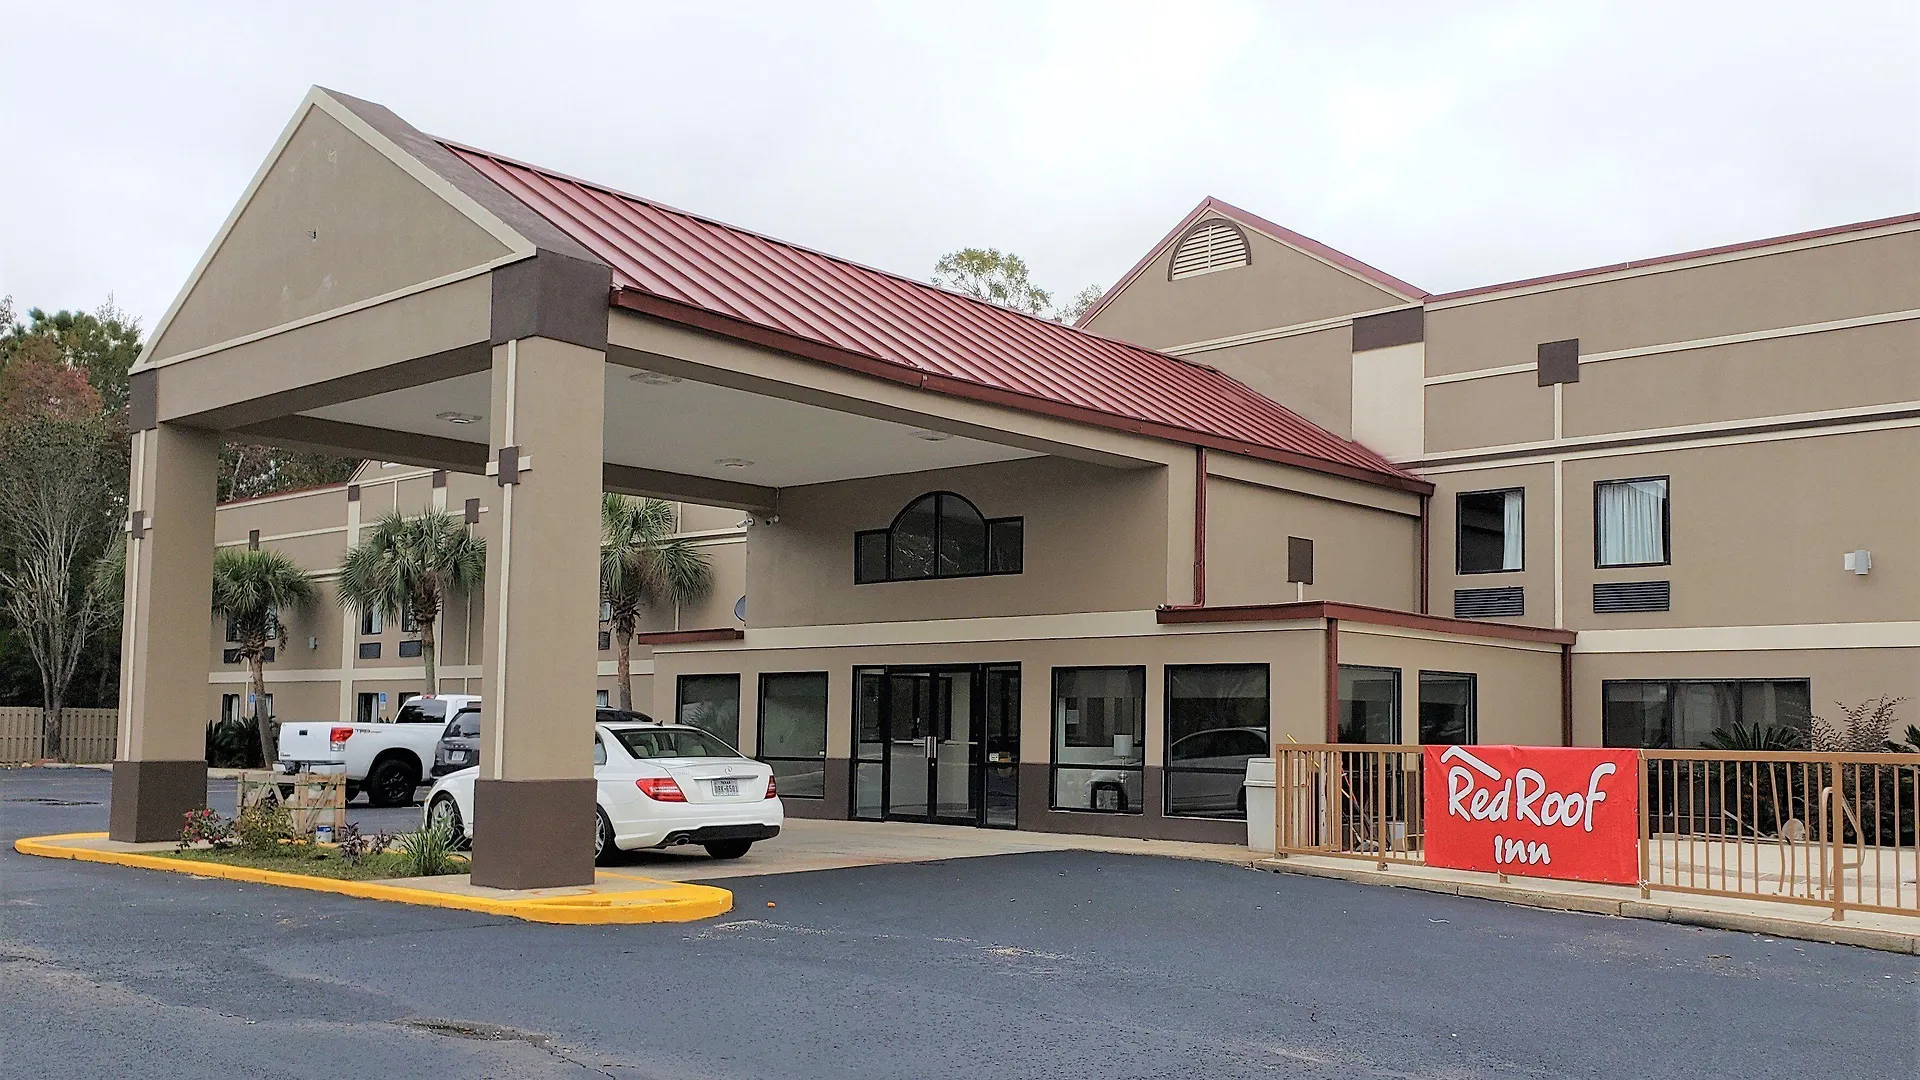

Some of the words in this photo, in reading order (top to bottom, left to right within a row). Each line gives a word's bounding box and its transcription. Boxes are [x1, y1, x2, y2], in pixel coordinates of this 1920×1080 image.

[1448, 765, 1513, 822] Red
[1515, 762, 1616, 832] Roof
[1494, 835, 1551, 865] Inn
